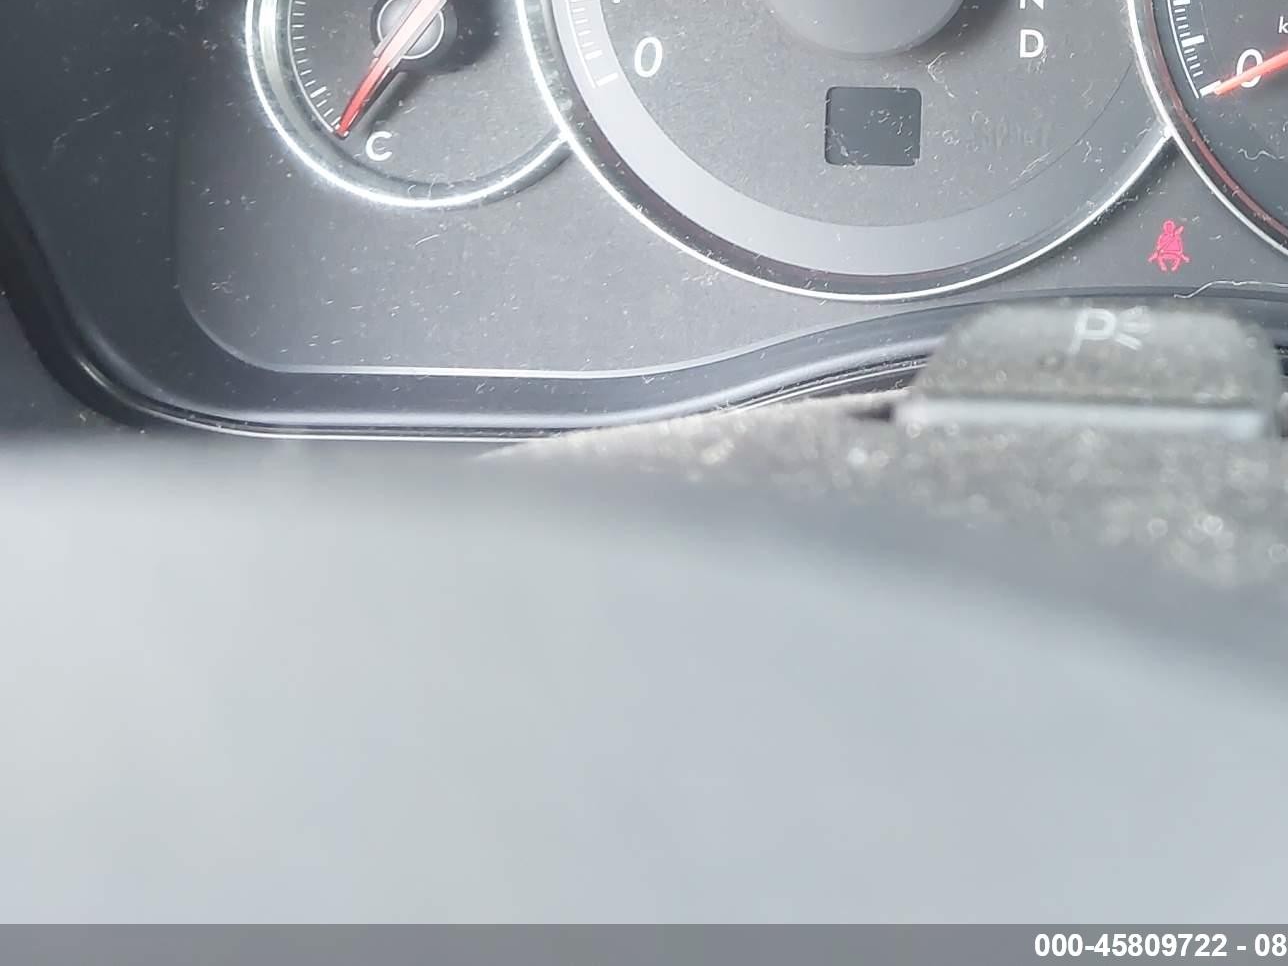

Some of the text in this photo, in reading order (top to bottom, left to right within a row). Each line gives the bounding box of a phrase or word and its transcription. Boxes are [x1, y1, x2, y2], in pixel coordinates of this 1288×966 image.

[634, 37, 663, 77] 0
[1019, 29, 1045, 59] D
[1236, 48, 1264, 88] 0
[365, 130, 393, 162] C
